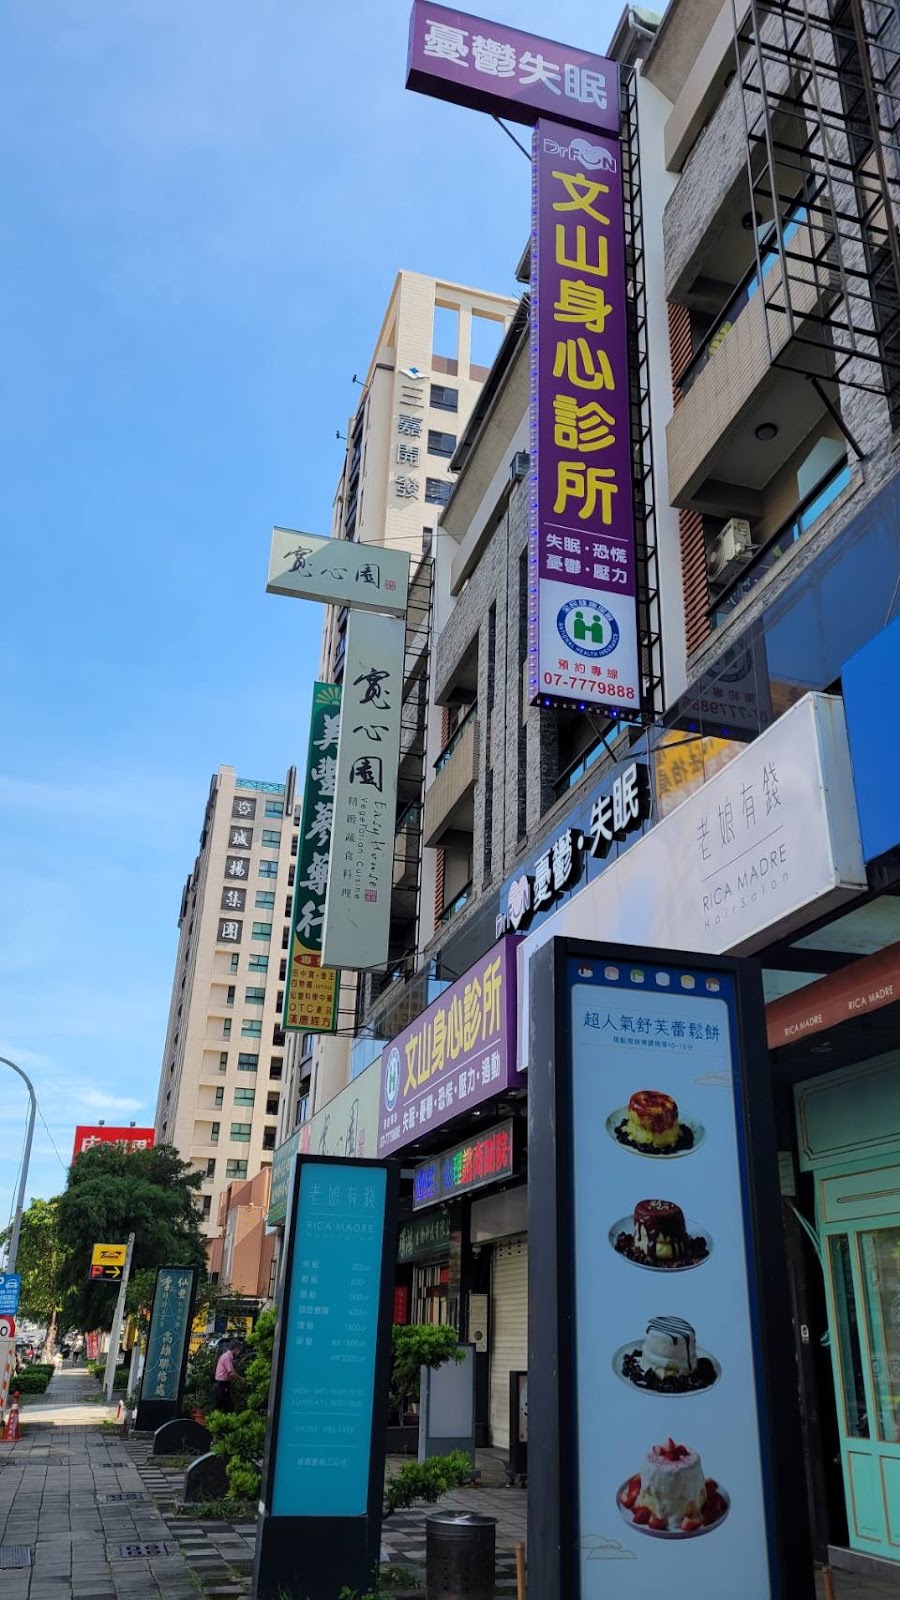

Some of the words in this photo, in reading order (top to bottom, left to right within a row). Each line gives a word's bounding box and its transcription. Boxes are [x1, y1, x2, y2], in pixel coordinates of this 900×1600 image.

[424, 19, 608, 110] 憂鬱失眠
[552, 170, 618, 525] 文山身心診所
[395, 385, 424, 501] 三嘉開發
[283, 545, 381, 589] 寬心園
[543, 671, 635, 700] 07-7779888
[350, 668, 391, 792] 寬心園
[696, 761, 782, 861] 老娘有錢
[702, 883, 732, 913] RICA
[737, 844, 788, 891] MADRE
[403, 955, 502, 1097] 文山身心診所
[583, 1011, 721, 1042] 超人氣舒芙蕾鬆餅
[784, 1024, 799, 1037] RICA
[800, 1013, 823, 1030] MADRE
[848, 997, 867, 1010] RICA
[868, 985, 894, 1003] MADRE
[307, 1220, 332, 1231] RICA
[335, 1223, 375, 1233] MADRE
